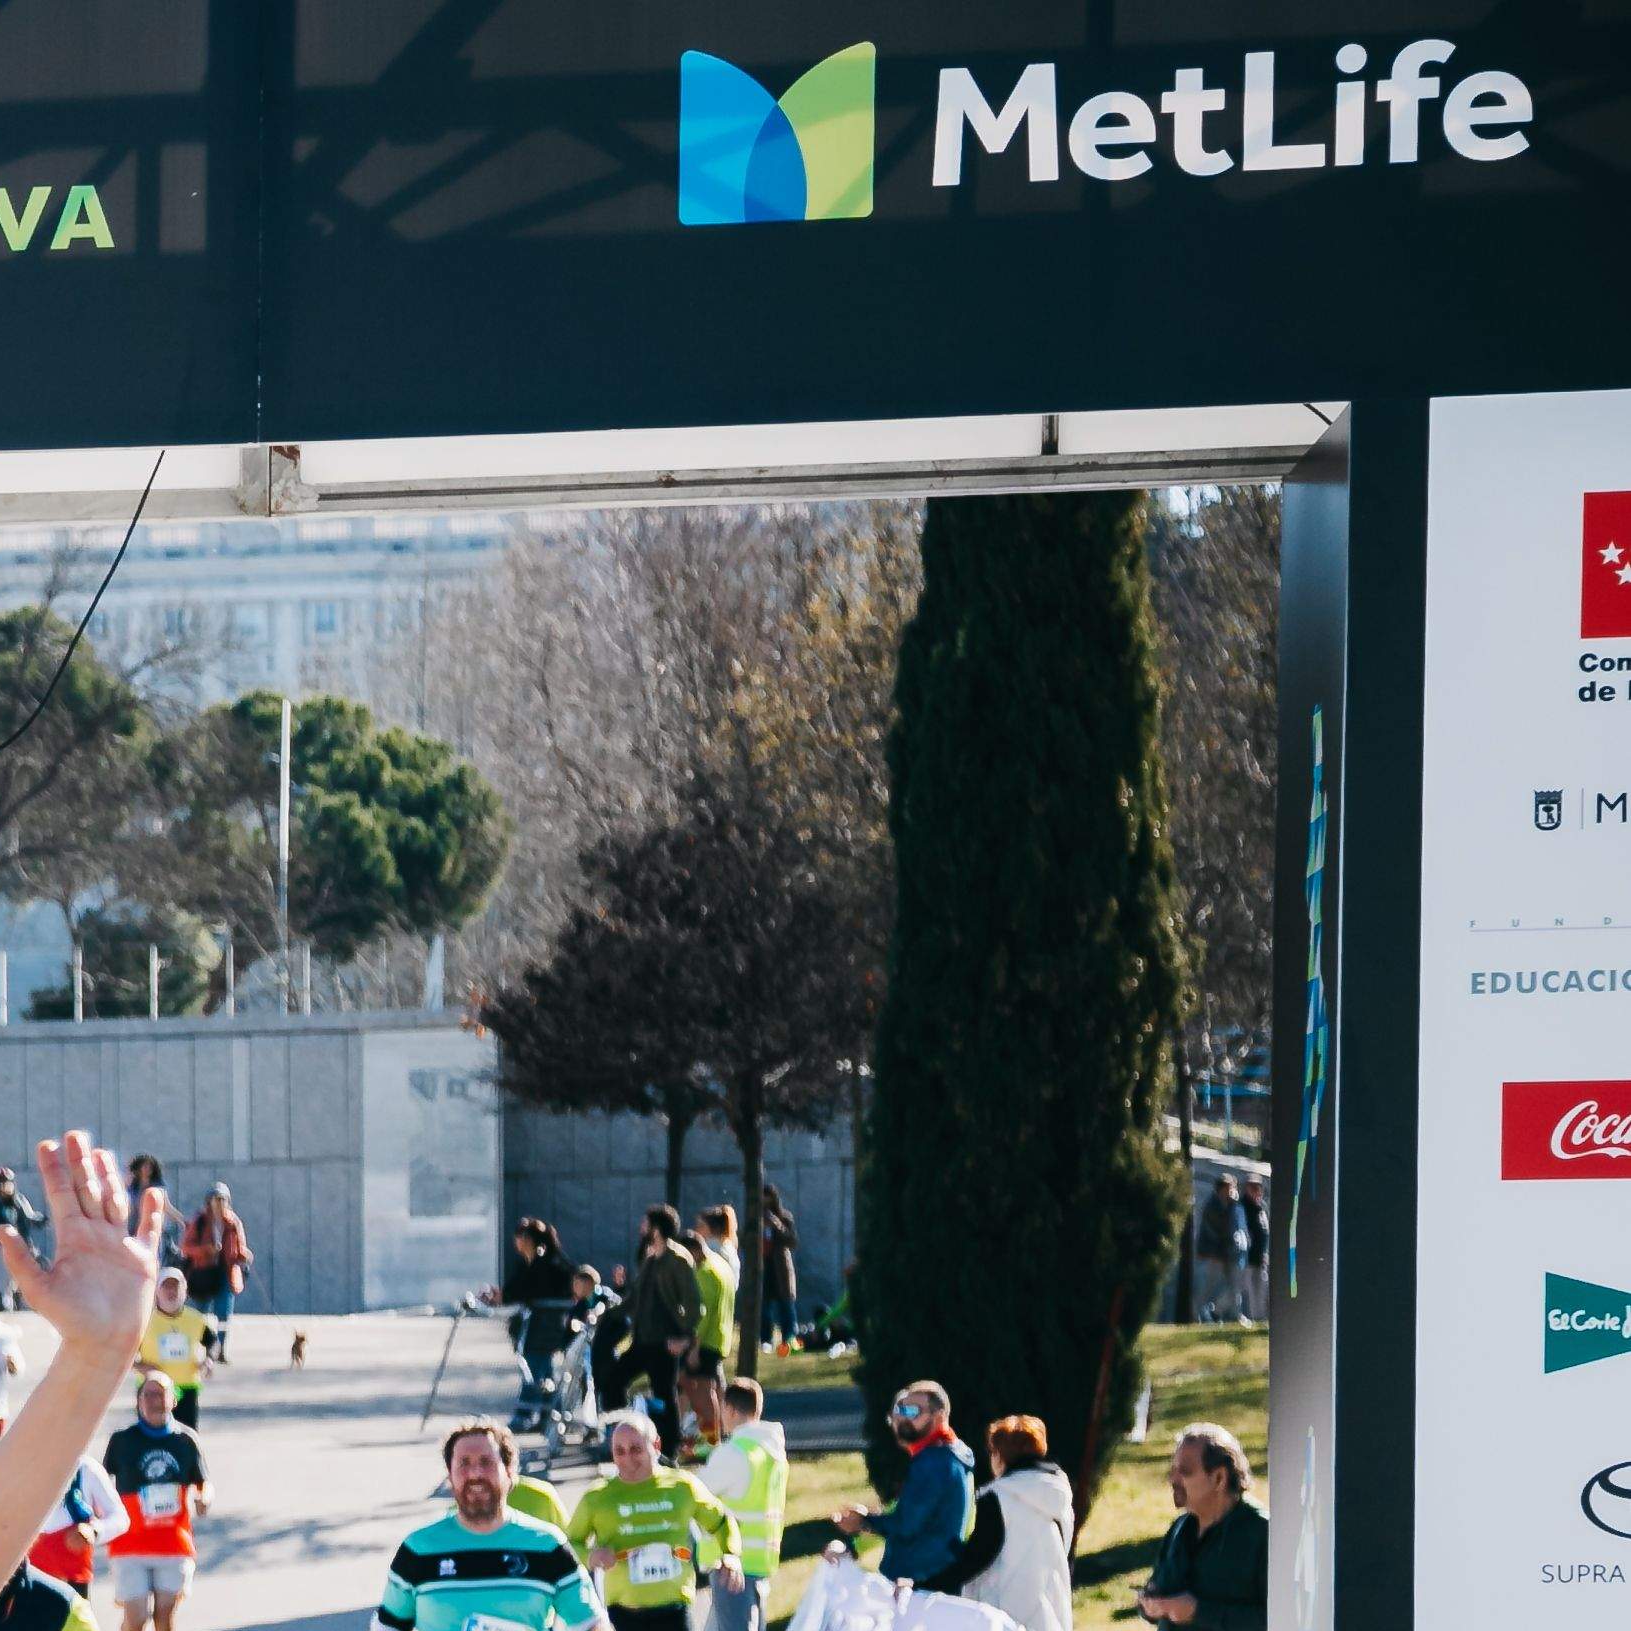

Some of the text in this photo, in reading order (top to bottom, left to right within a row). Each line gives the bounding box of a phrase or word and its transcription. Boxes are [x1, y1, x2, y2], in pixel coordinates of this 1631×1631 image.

[932, 38, 1534, 187] MetLife
[1578, 681, 1616, 704] de
[1542, 1564, 1625, 1583] SUPRA
